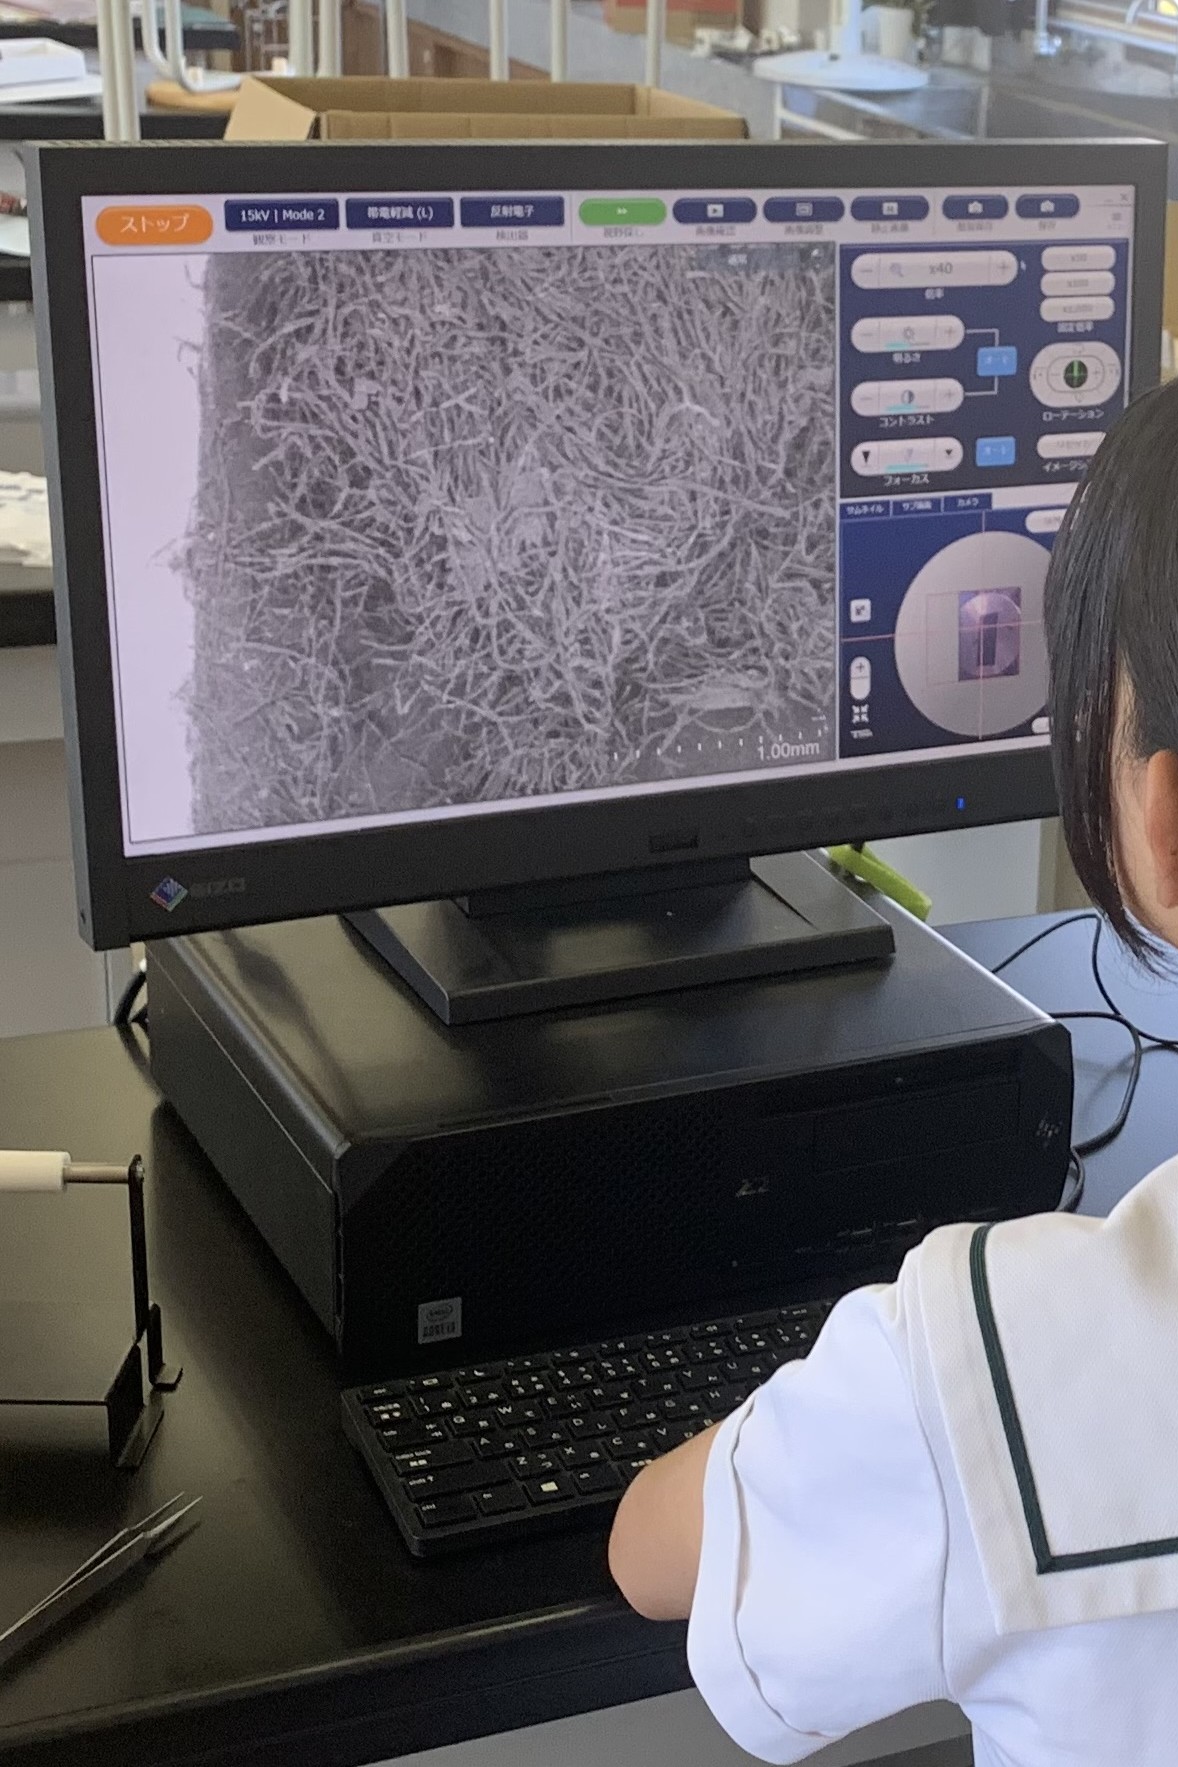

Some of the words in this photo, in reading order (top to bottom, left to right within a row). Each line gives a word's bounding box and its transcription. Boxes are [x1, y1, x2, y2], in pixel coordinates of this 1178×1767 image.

[240, 208, 270, 223] 15kV
[282, 208, 314, 221] Mode
[317, 208, 325, 221] 2
[491, 204, 535, 219] 反射電子
[120, 213, 190, 234] ストップ
[929, 263, 953, 275] x40
[879, 415, 935, 427] コントラスト
[1042, 409, 1105, 422] ローテーション
[884, 474, 930, 486] フォーカス
[758, 742, 820, 761] 1.00mm
